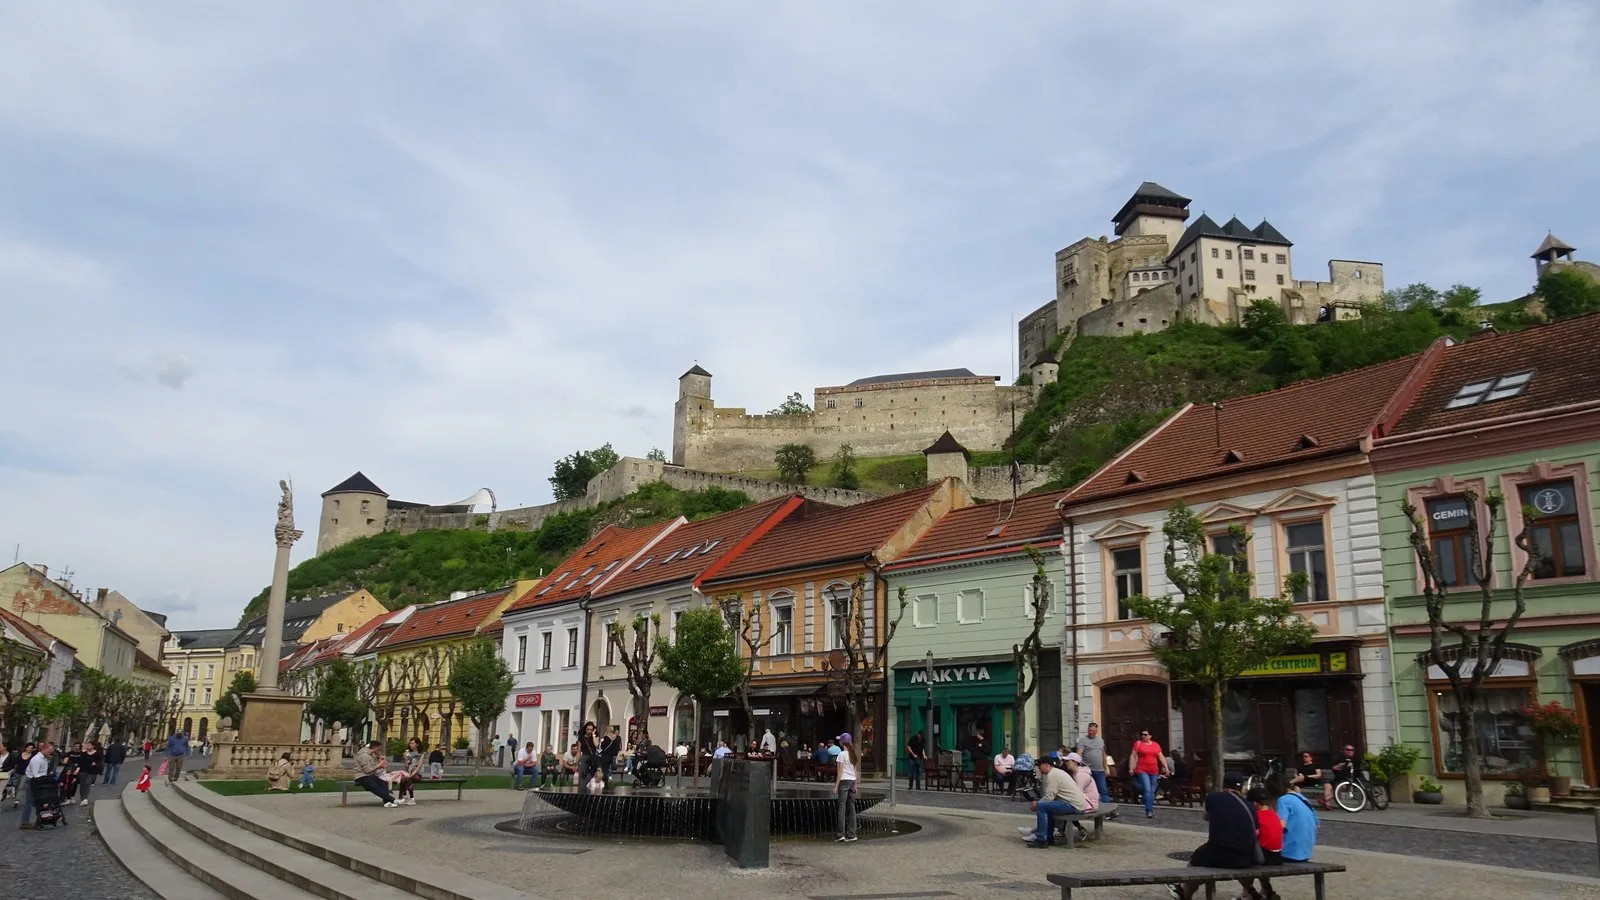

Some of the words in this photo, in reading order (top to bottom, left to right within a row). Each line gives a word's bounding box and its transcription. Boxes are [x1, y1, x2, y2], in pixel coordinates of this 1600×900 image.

[1433, 509, 1468, 520] GEMIN
[1271, 658, 1317, 670] CENTRUM
[910, 667, 990, 683] MAKYTA
